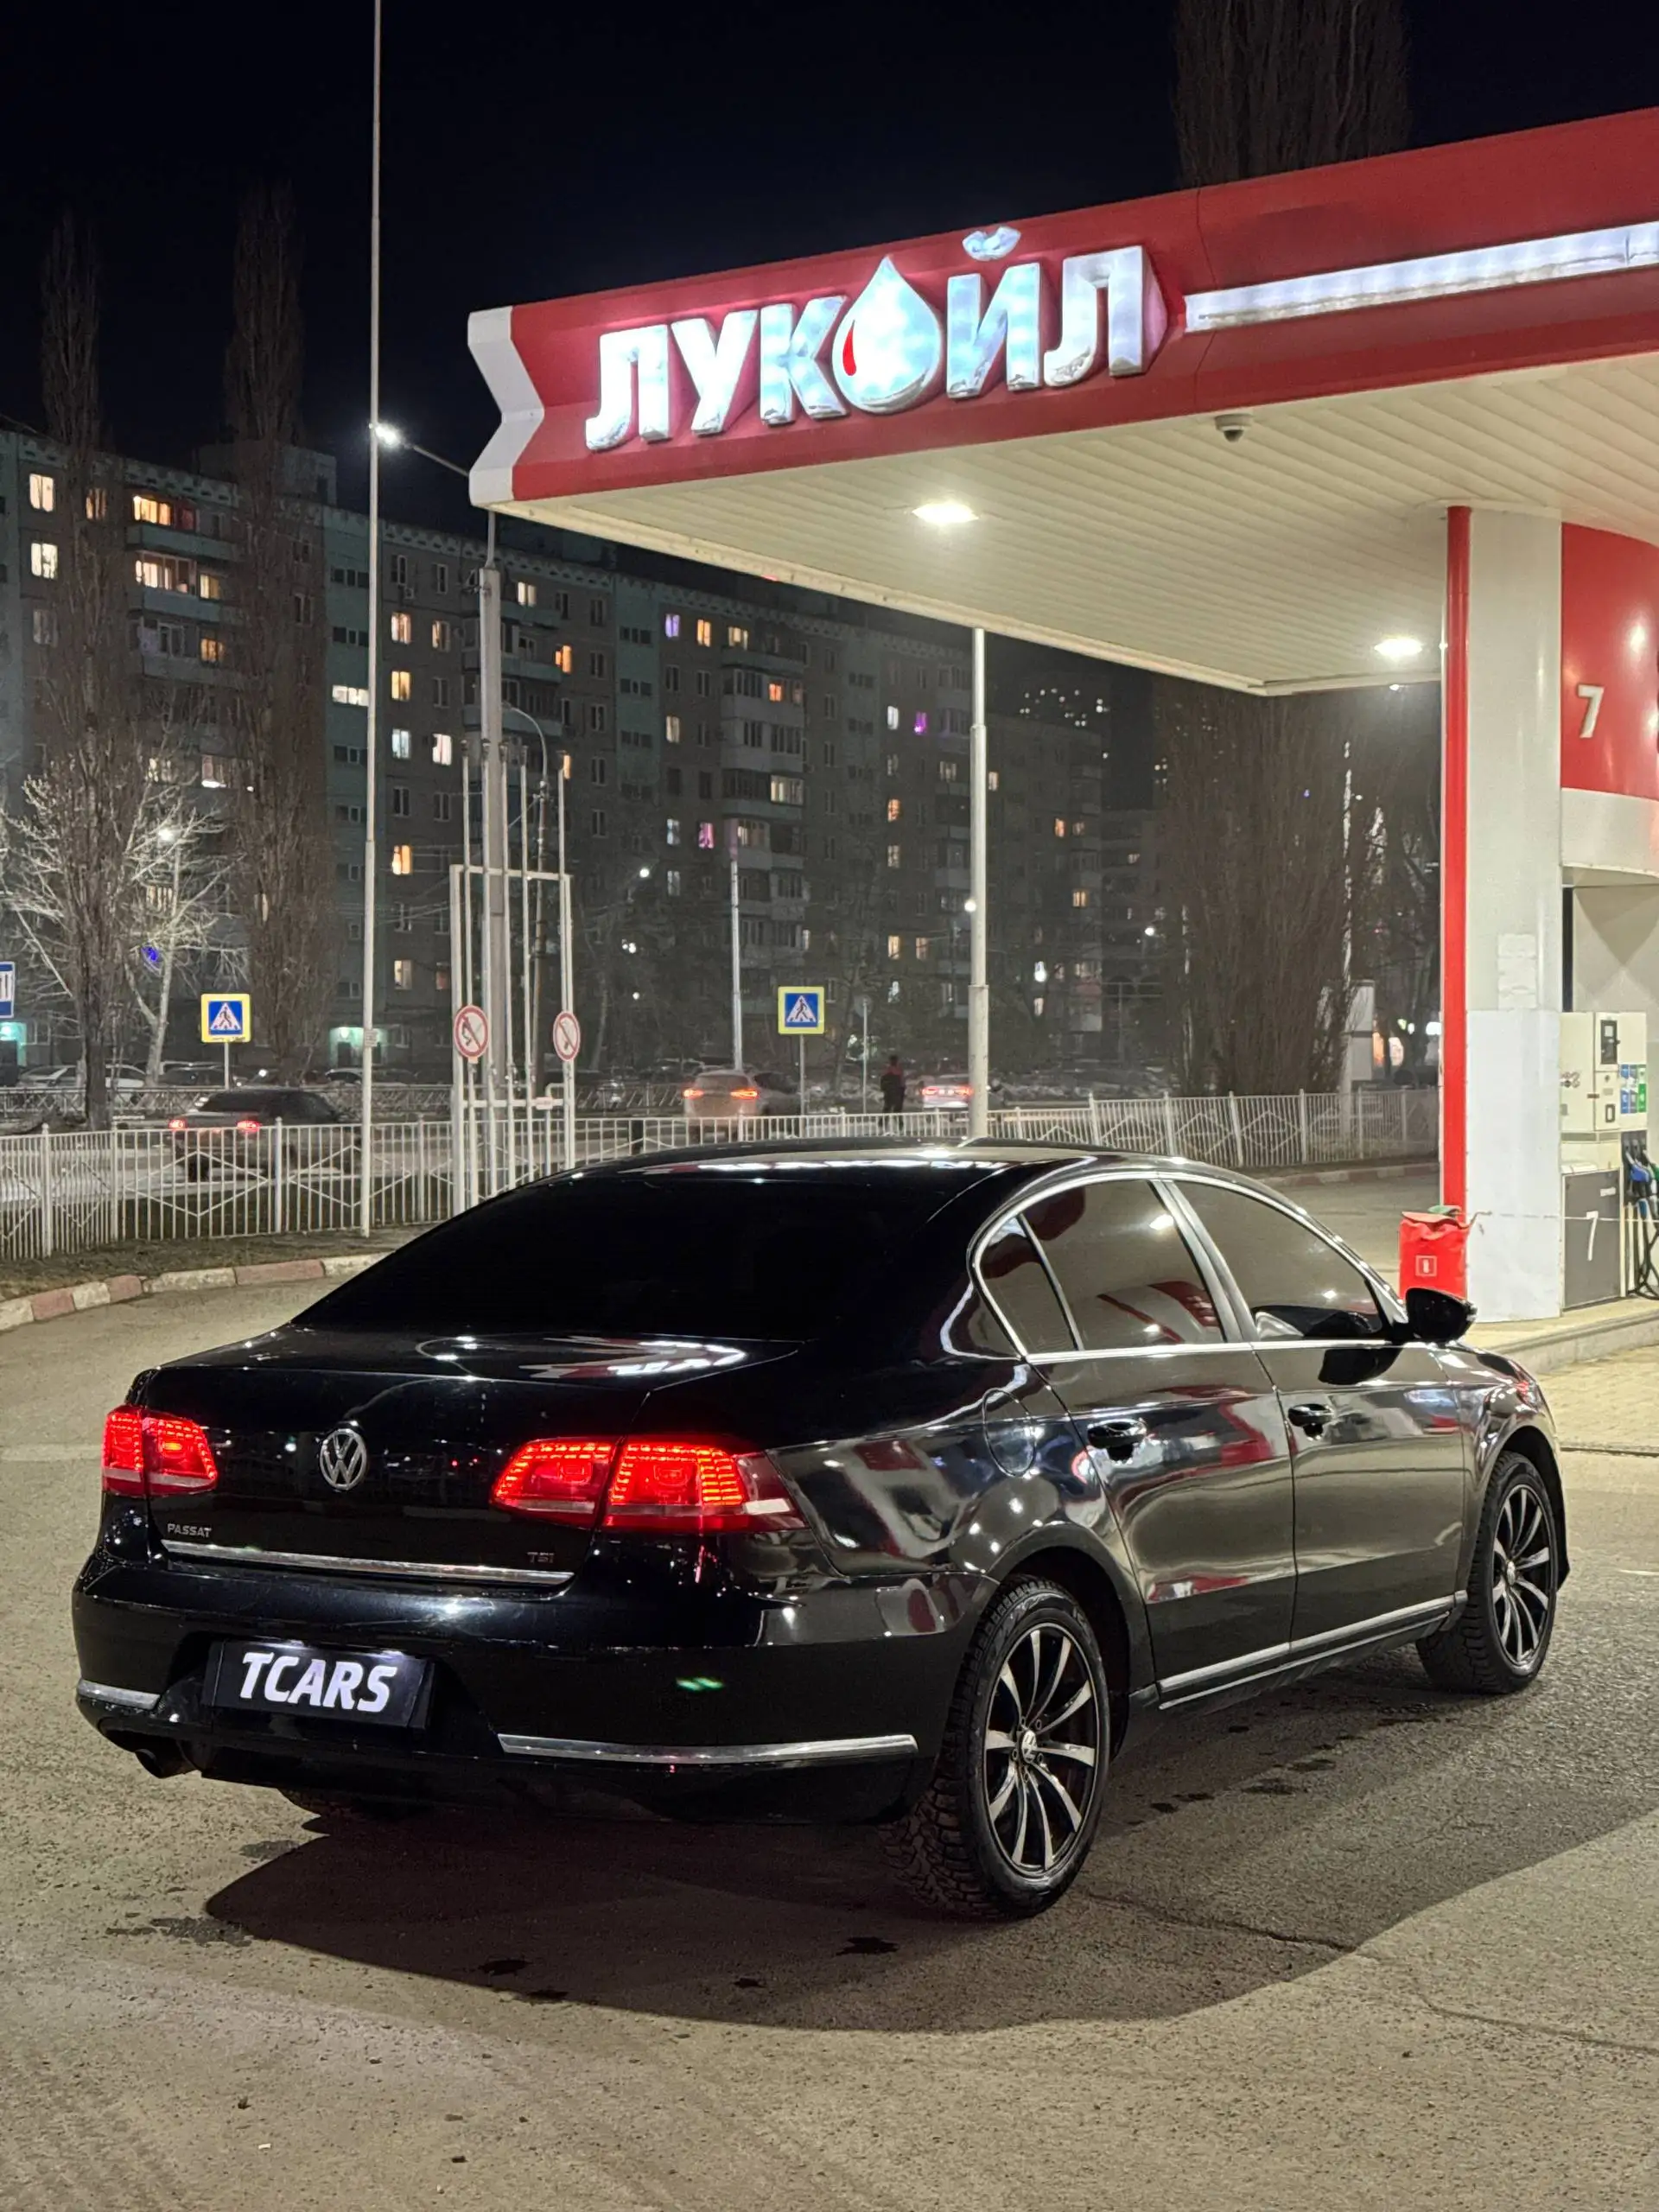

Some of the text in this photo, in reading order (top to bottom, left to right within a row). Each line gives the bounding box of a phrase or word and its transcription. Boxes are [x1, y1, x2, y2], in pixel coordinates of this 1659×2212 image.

[586, 226, 1146, 451] ЛУКОЙЛ
[1578, 683, 1605, 739] 7
[1586, 1211, 1599, 1262] 7
[167, 1523, 213, 1538] PASSAT
[240, 1652, 397, 1713] TCARS
